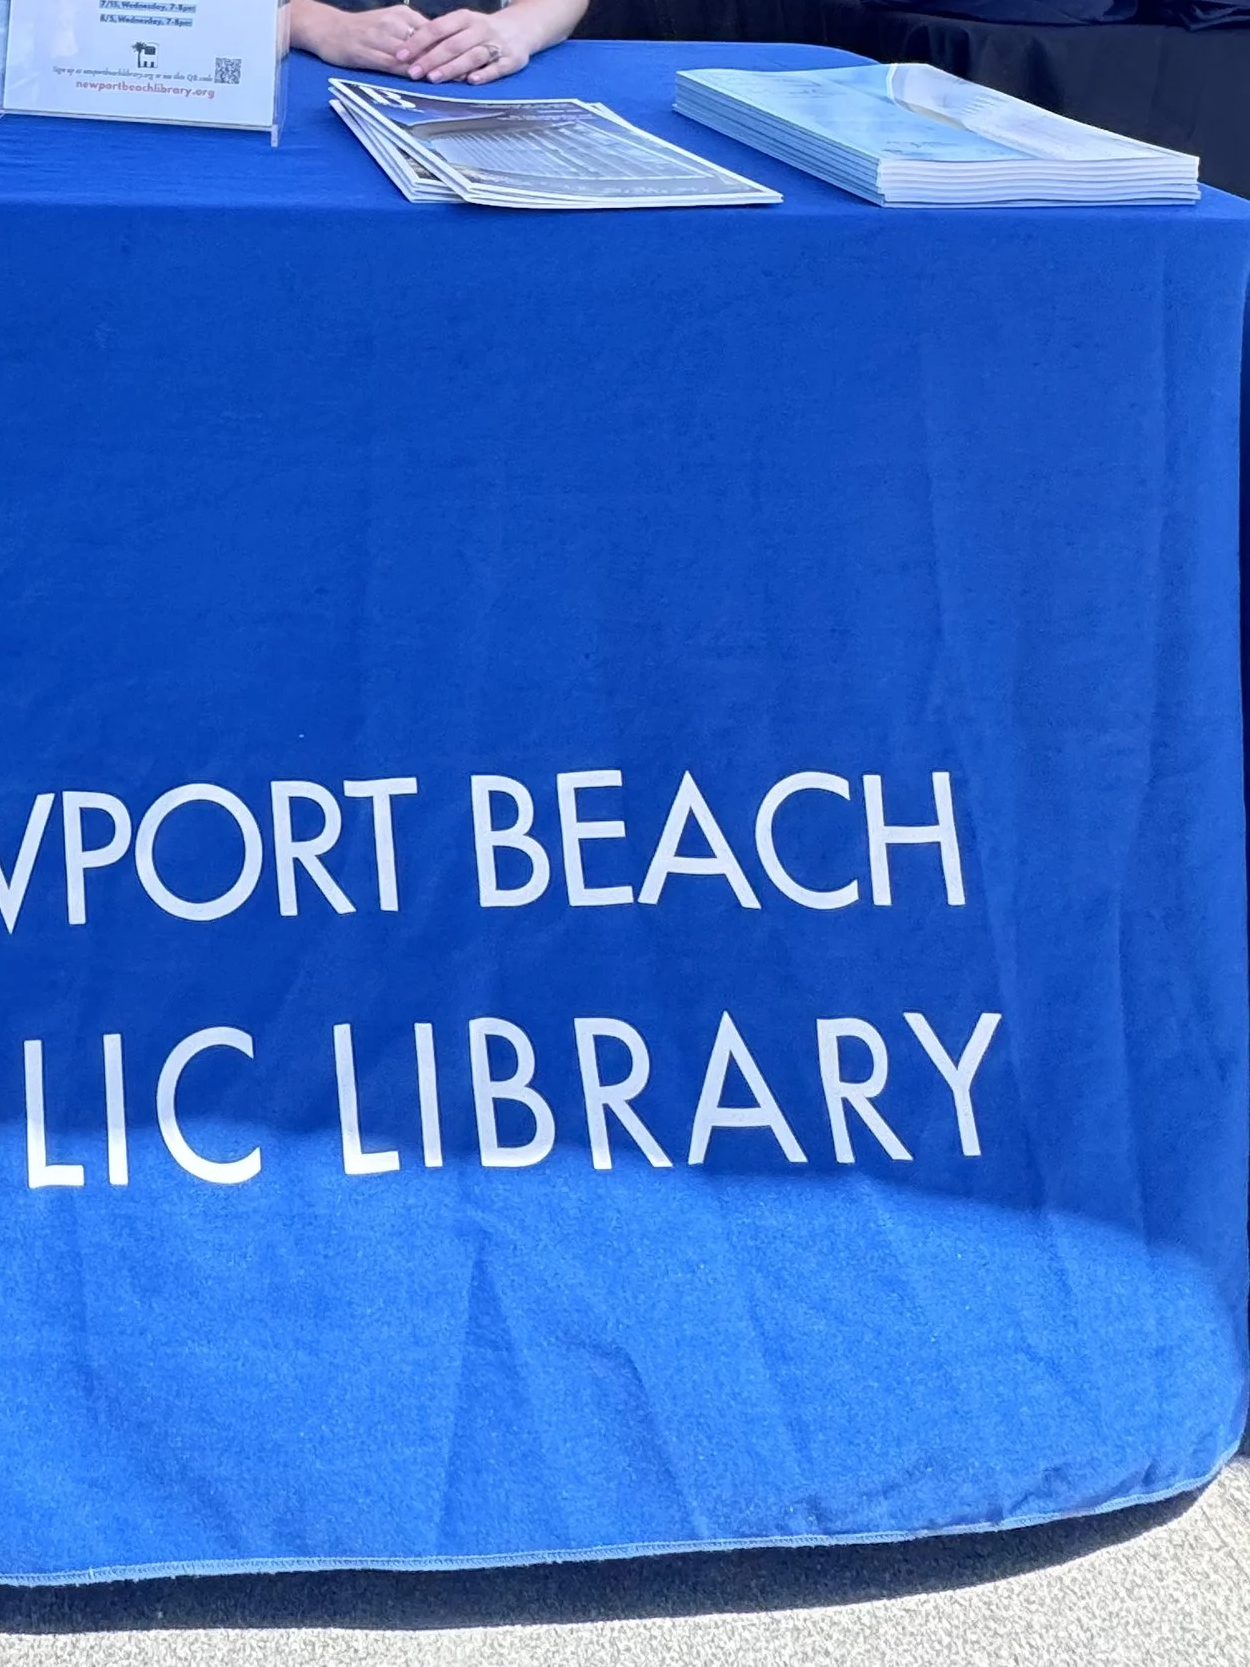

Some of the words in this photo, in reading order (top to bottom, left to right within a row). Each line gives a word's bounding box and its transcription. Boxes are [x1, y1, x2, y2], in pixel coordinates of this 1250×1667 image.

[76, 81, 215, 99] newportbeachlibrary.org
[470, 769, 966, 909] BEACH
[332, 1011, 1001, 1175] LIBRARY
